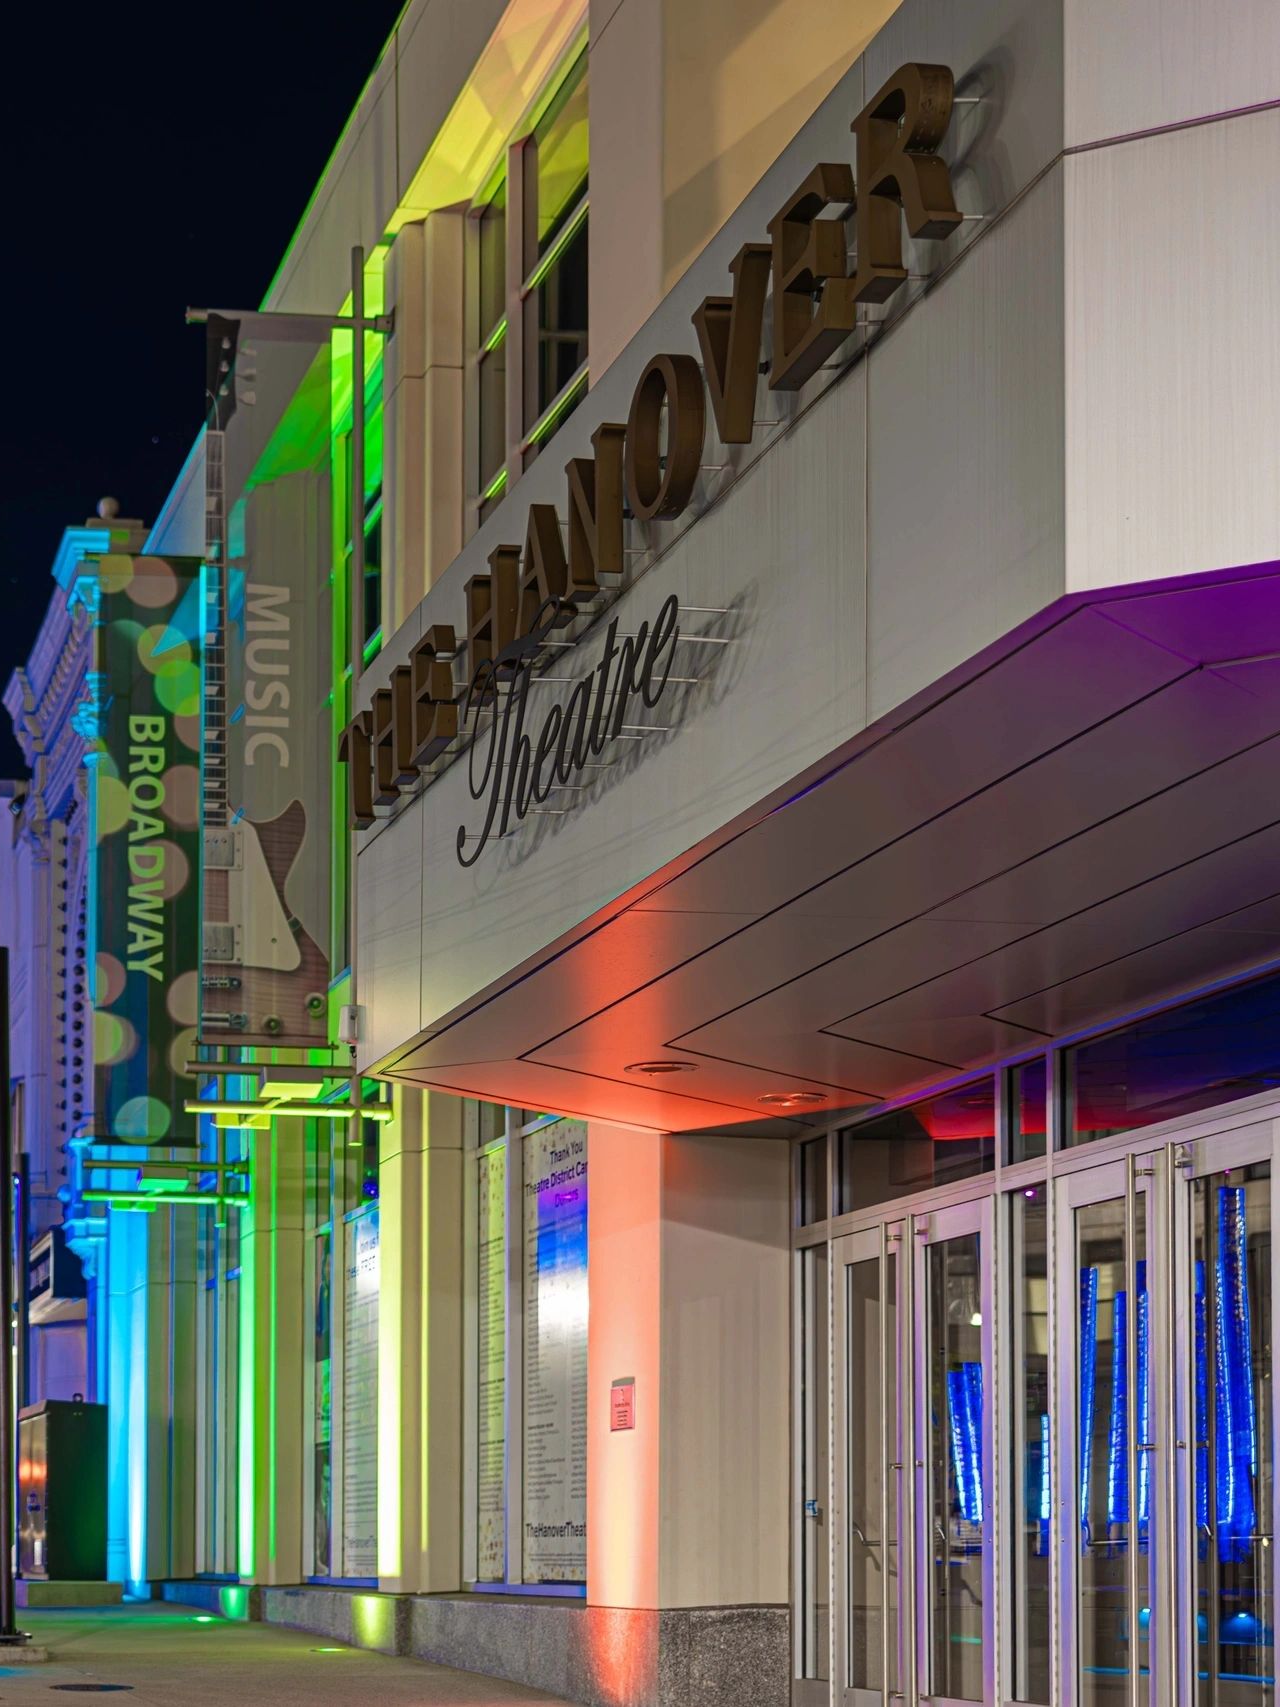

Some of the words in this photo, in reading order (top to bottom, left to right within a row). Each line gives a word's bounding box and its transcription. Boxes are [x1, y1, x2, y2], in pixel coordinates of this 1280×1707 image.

[338, 624, 458, 831] THE
[462, 62, 964, 700] HANOVER
[243, 582, 291, 769] MUSIC
[456, 594, 680, 868] Theatre
[127, 714, 166, 983] BROADWAY
[524, 1177, 550, 1197] Theatre
[550, 1164, 576, 1188] District
[549, 1144, 570, 1165] Thank
[570, 1140, 584, 1157] You
